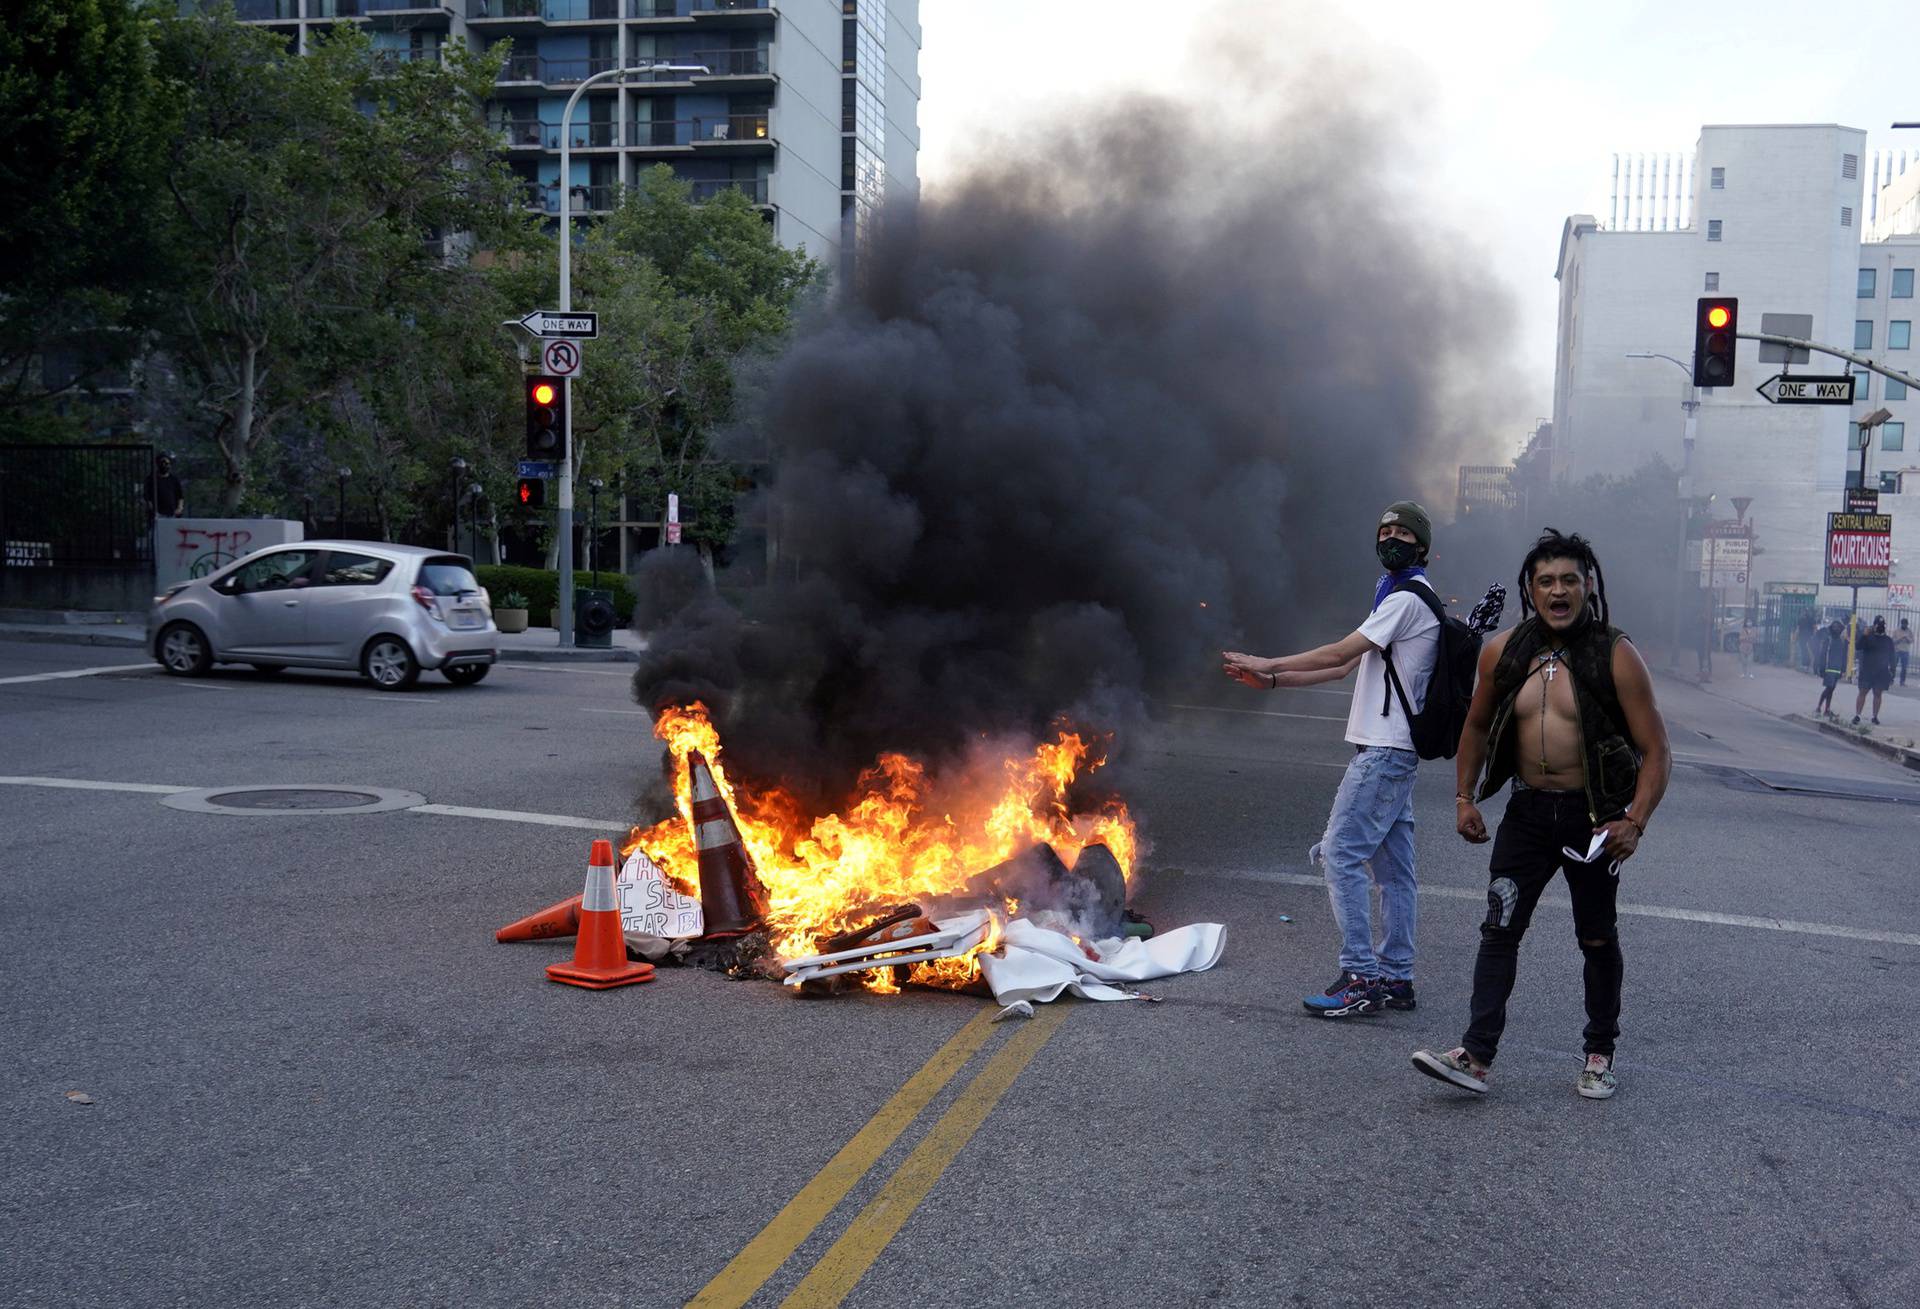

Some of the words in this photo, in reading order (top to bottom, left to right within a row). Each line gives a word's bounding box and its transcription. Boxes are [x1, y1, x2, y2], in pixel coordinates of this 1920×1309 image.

[543, 320, 565, 330] ONE
[567, 320, 589, 330] WAY
[1778, 384, 1807, 397] ONE
[1816, 384, 1846, 397] WAY
[1833, 514, 1863, 530] CENTRAL
[1864, 515, 1891, 531] MARKET
[177, 528, 252, 570] FTP
[1831, 534, 1890, 566] COURTHOUSE
[1829, 568, 1850, 578] LABOR
[1851, 568, 1888, 579] COMMISSION
[1889, 585, 1913, 597] ATM
